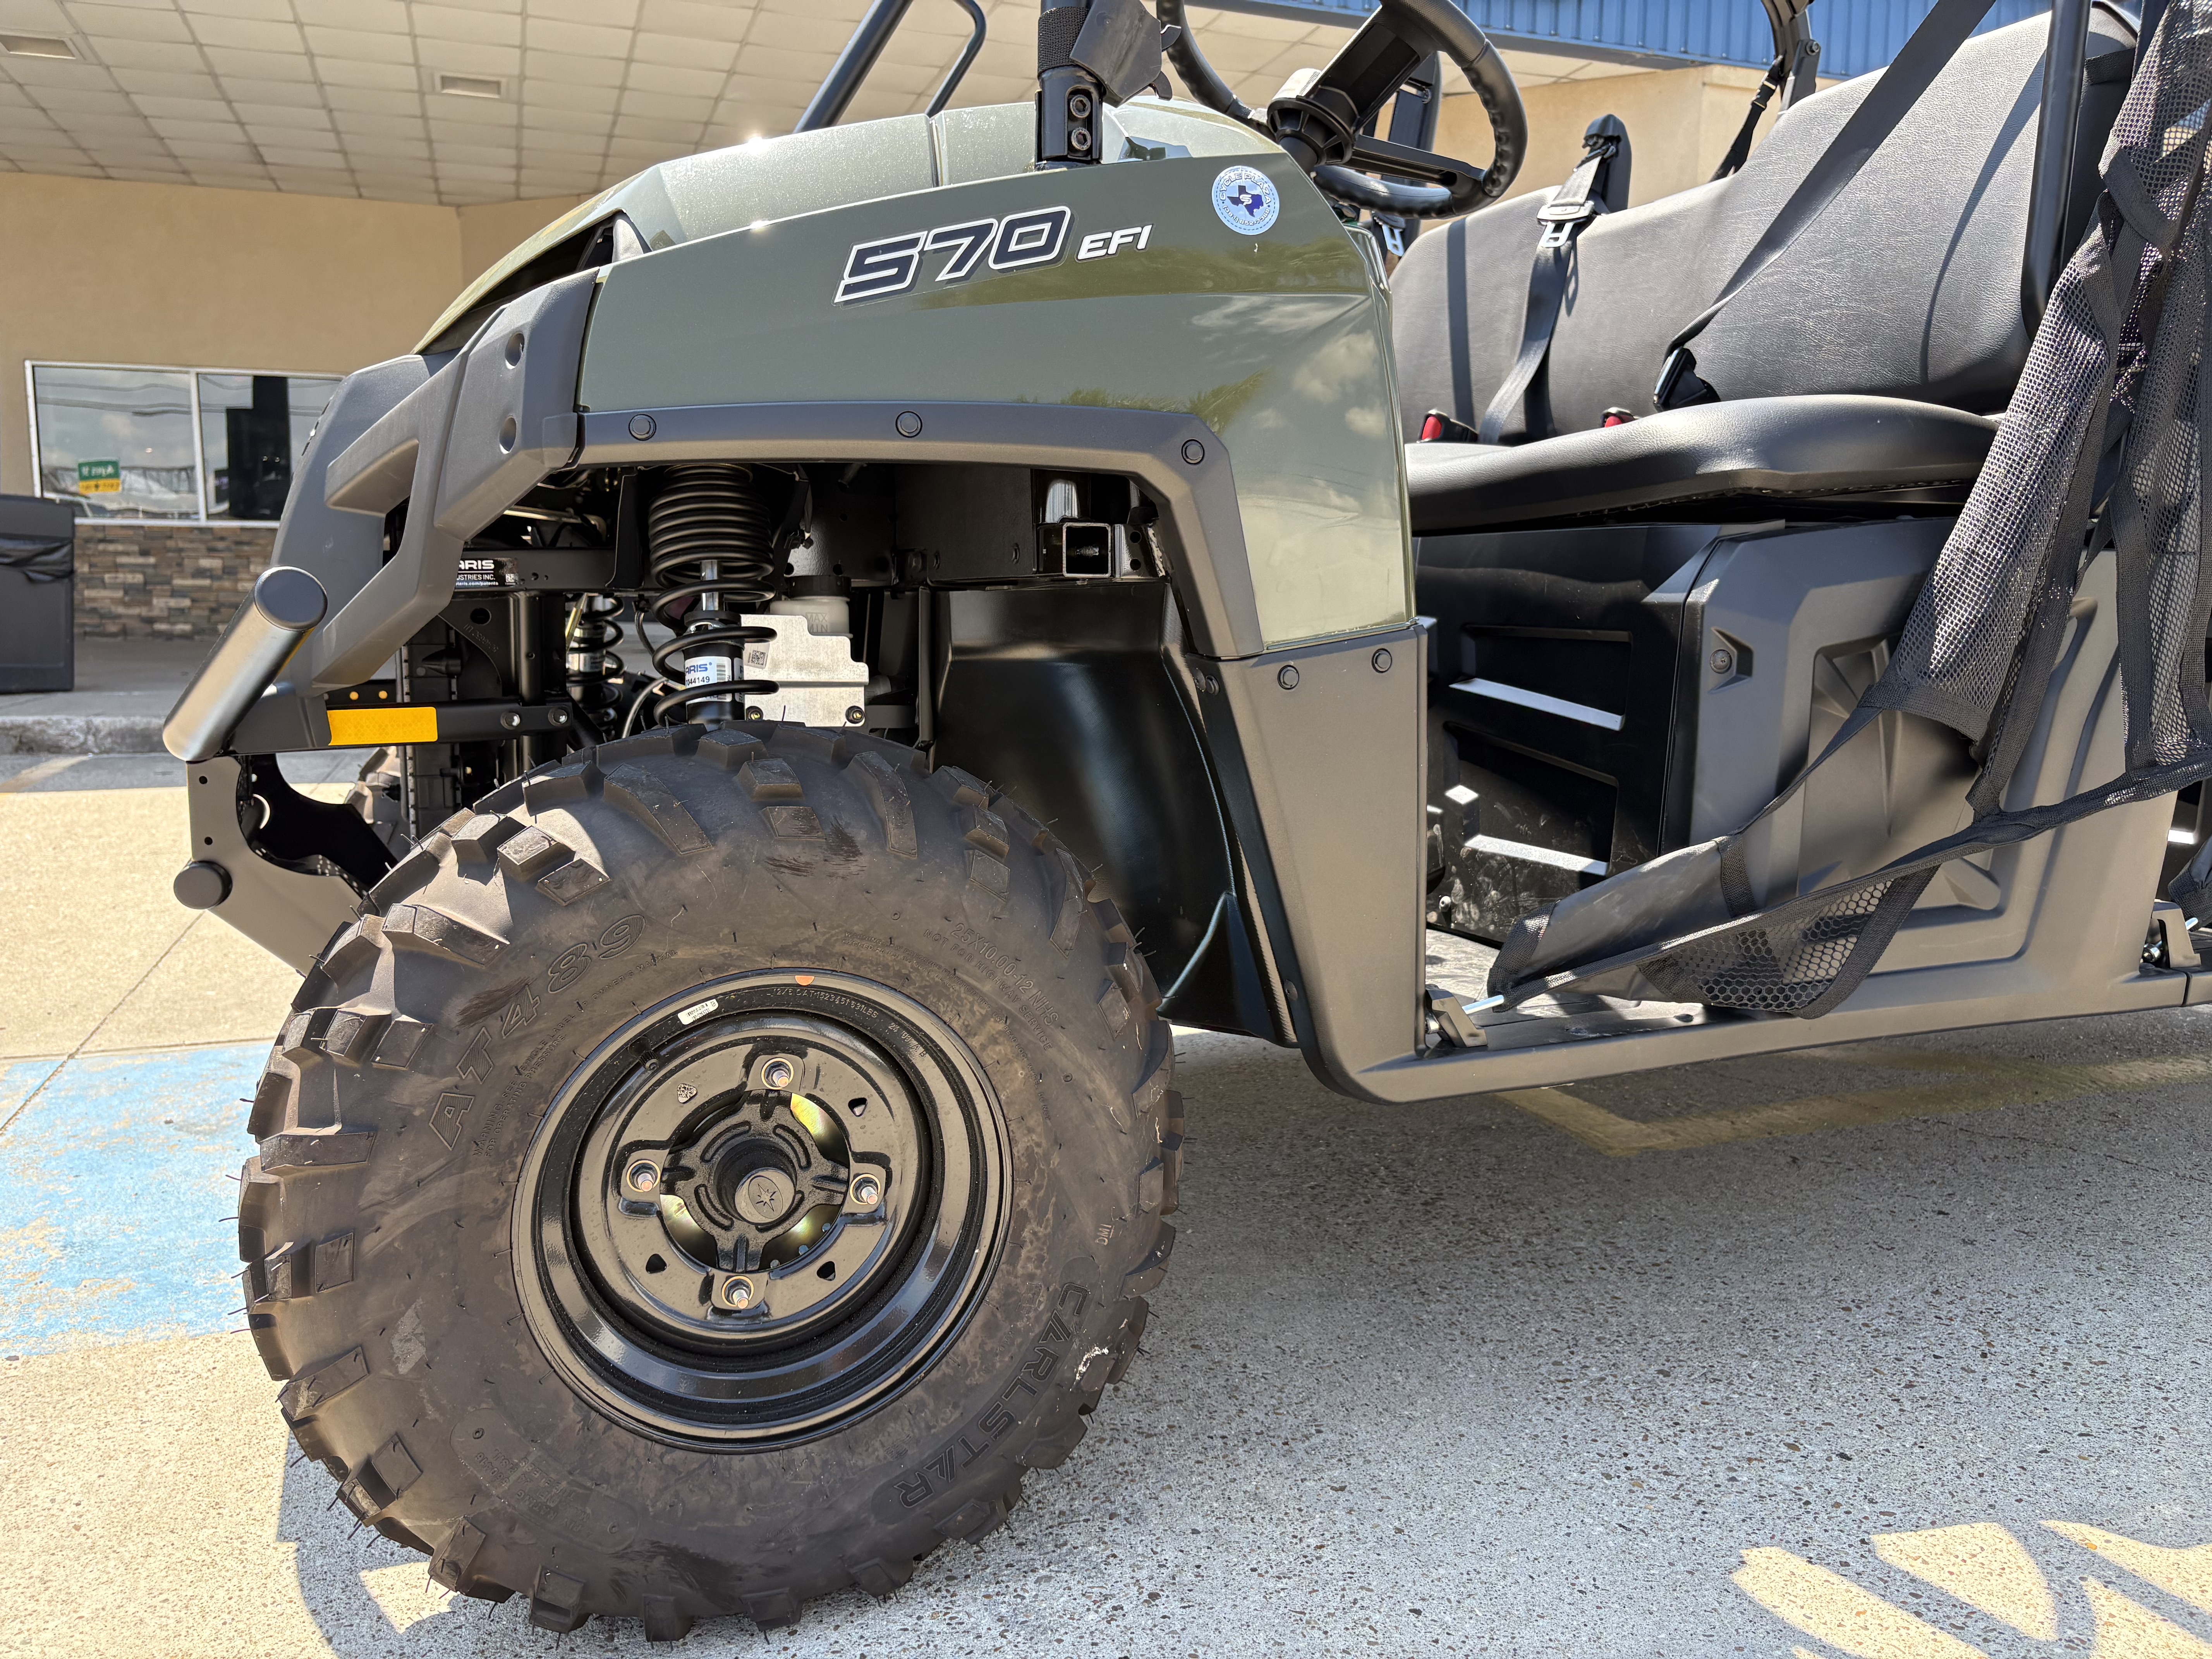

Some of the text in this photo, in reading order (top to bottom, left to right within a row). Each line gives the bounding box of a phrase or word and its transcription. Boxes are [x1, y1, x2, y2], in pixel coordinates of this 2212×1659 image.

[1219, 173, 1271, 204] CYCLE PLAZA
[834, 206, 1152, 304] 570 EFI
[806, 613, 827, 622] MAX
[924, 929, 1053, 1052] NOT FOR HIGHWAY SERVICE
[1028, 990, 1059, 1026] NHS
[501, 1079, 517, 1098] SEE
[515, 1038, 548, 1078] VEHICLE
[547, 1012, 576, 1040] LABEL
[484, 1137, 497, 1158] FOR
[493, 1080, 527, 1135] OPERATING
[893, 1283, 1089, 1508] CARLSTAR
